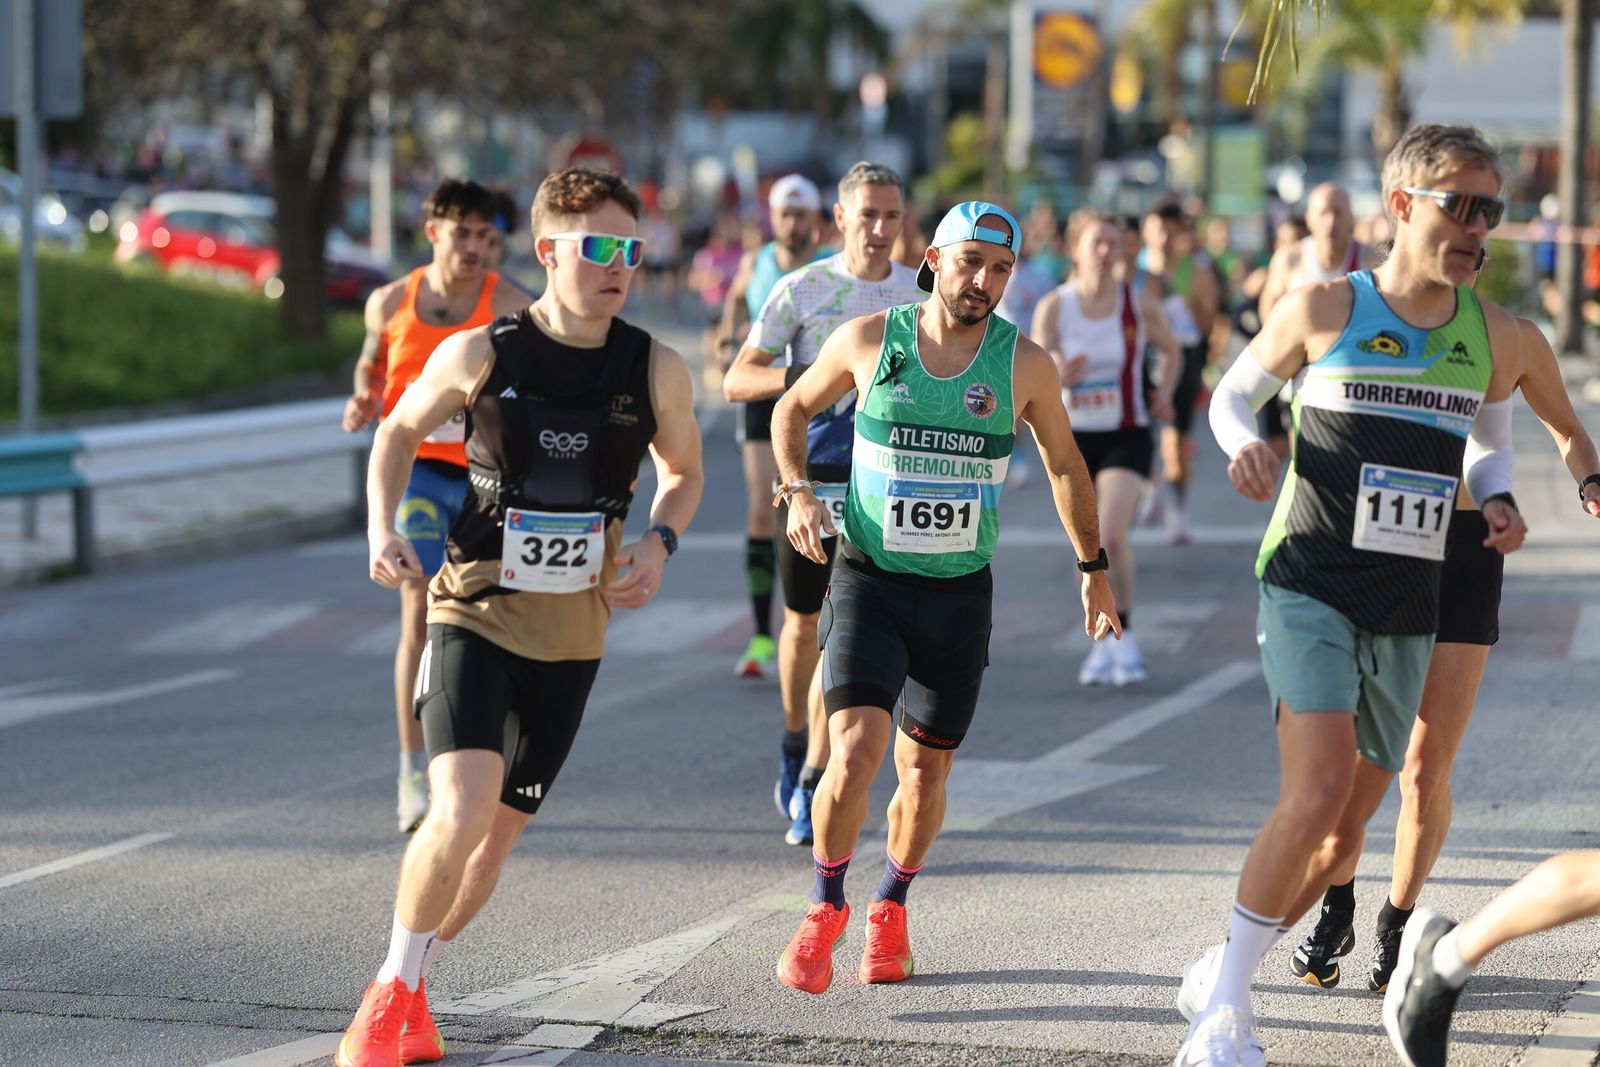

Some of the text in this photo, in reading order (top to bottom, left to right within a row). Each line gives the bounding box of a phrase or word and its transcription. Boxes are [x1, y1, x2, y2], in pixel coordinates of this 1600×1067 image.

[1342, 382, 1479, 417] TORREMOLINOS
[889, 426, 985, 453] ATLETISMO
[876, 450, 993, 479] TORREMOLINOS
[891, 500, 971, 530] 1691
[1368, 491, 1445, 532] 1111
[521, 536, 588, 567] 322
